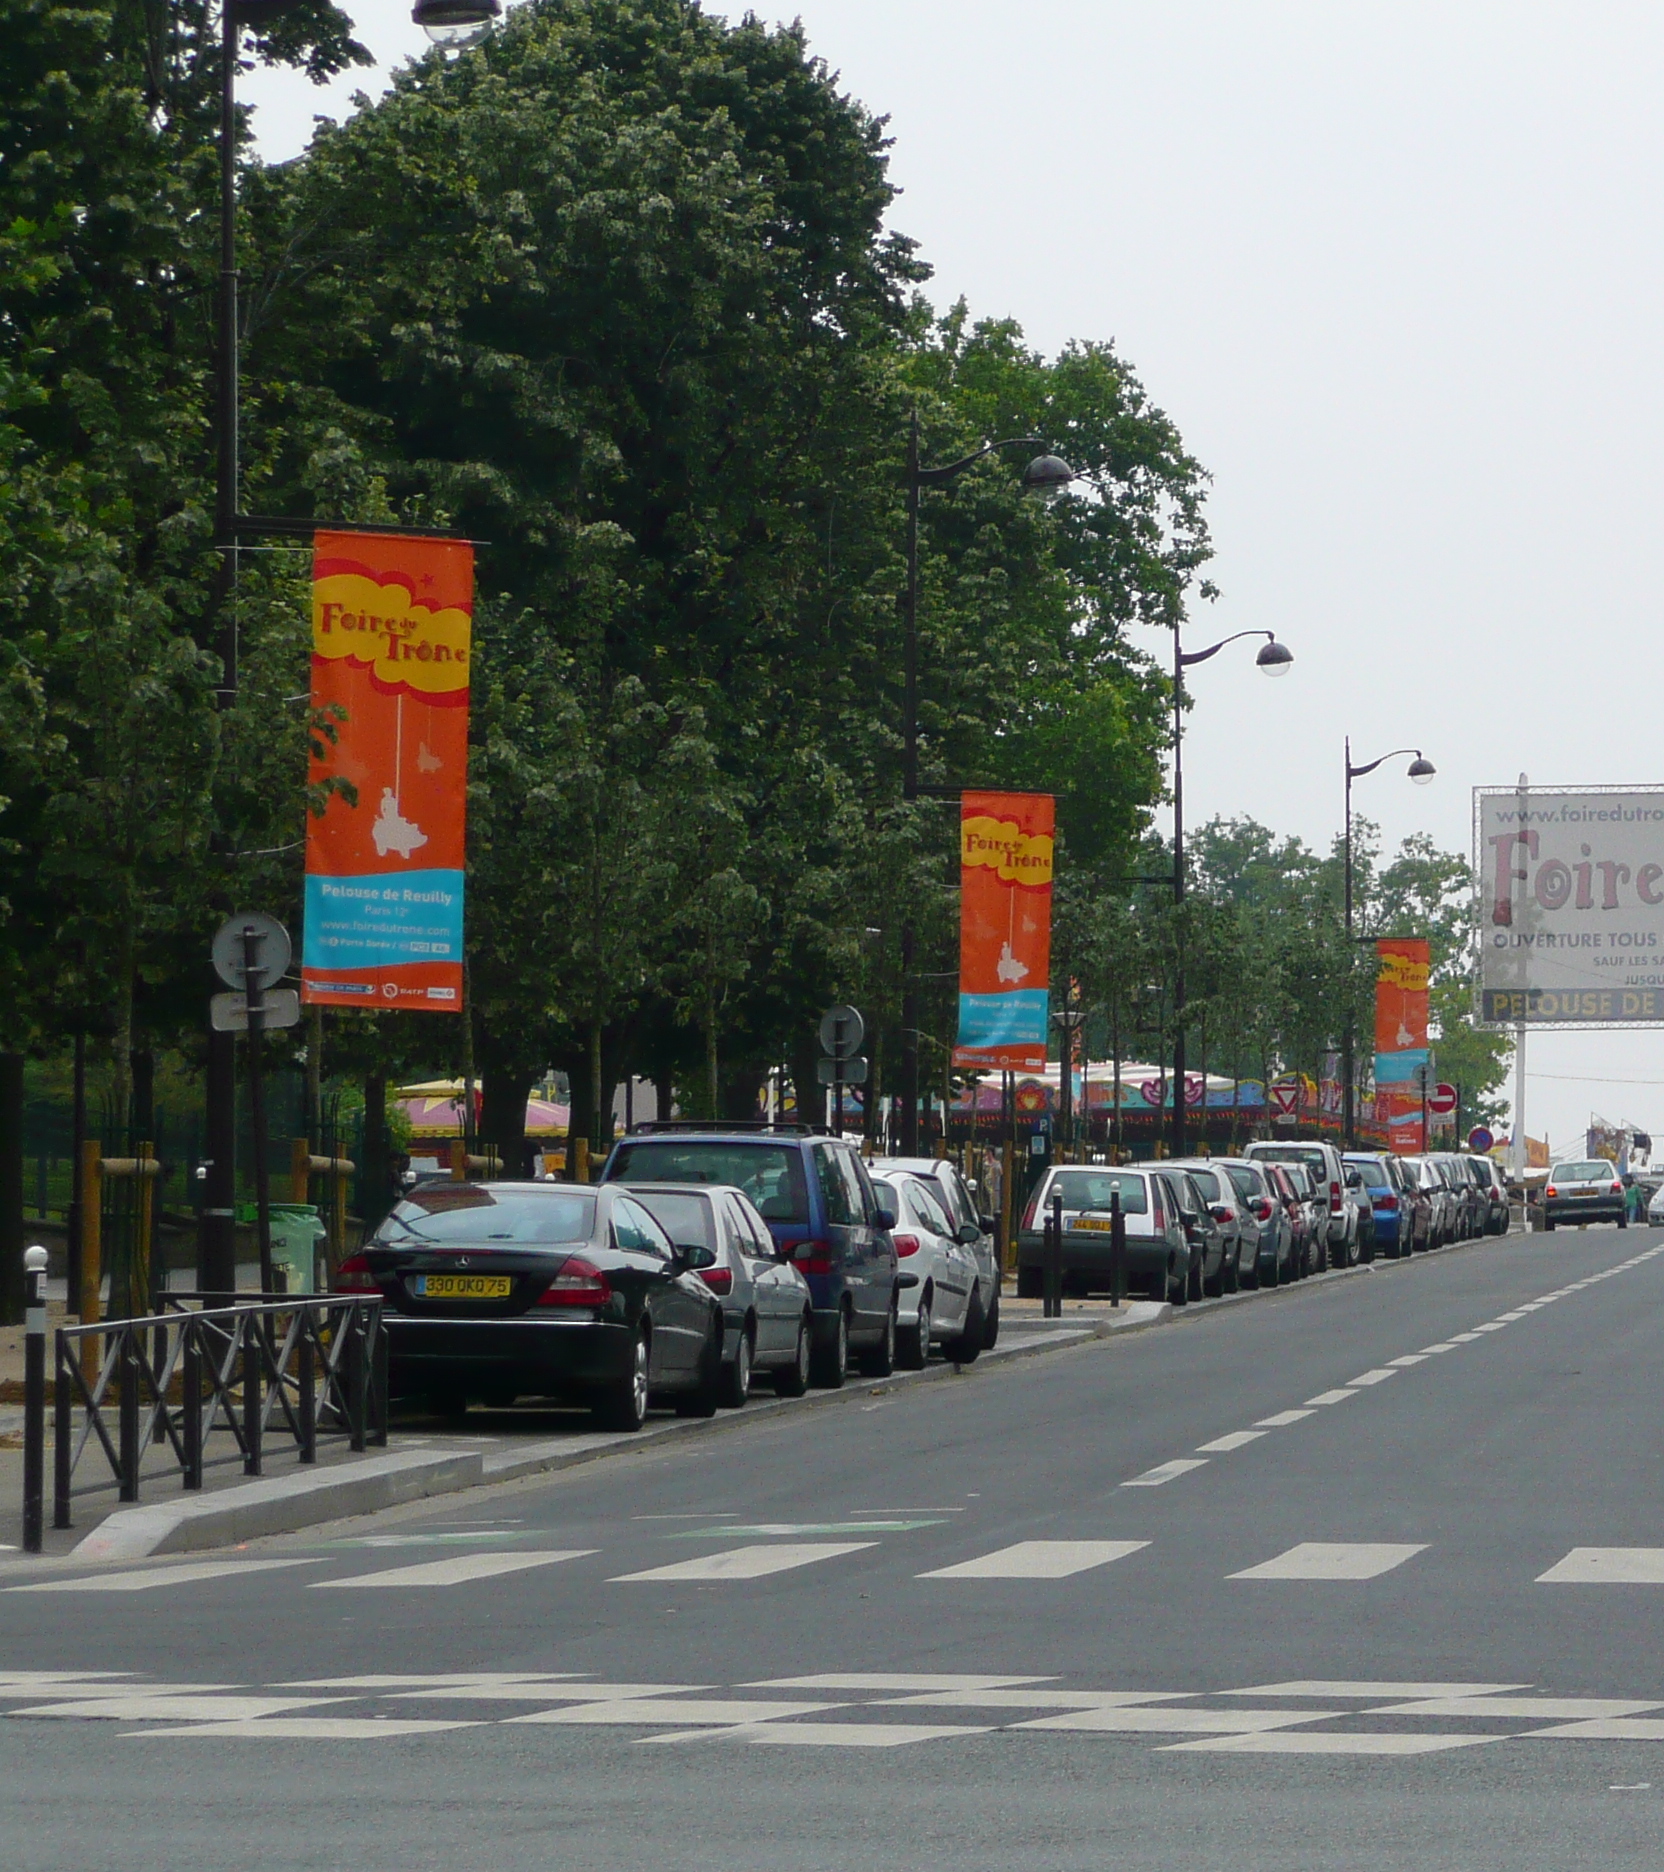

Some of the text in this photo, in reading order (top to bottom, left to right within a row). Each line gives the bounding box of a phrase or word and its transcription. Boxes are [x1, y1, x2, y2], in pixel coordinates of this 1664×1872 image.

[320, 603, 418, 634] Foire du
[379, 629, 467, 662] Trône
[1487, 829, 1664, 927] Foire
[322, 884, 452, 906] Pelouse de Reuilly
[1493, 931, 1601, 948] OUVERTURE
[1608, 932, 1657, 947] TOUS
[1593, 955, 1625, 967] SAUF
[1629, 955, 1648, 966] LES
[1492, 991, 1613, 1017] PELOUSE
[1622, 991, 1655, 1016] DE
[426, 1278, 454, 1291] 330
[487, 1279, 507, 1293] 75
